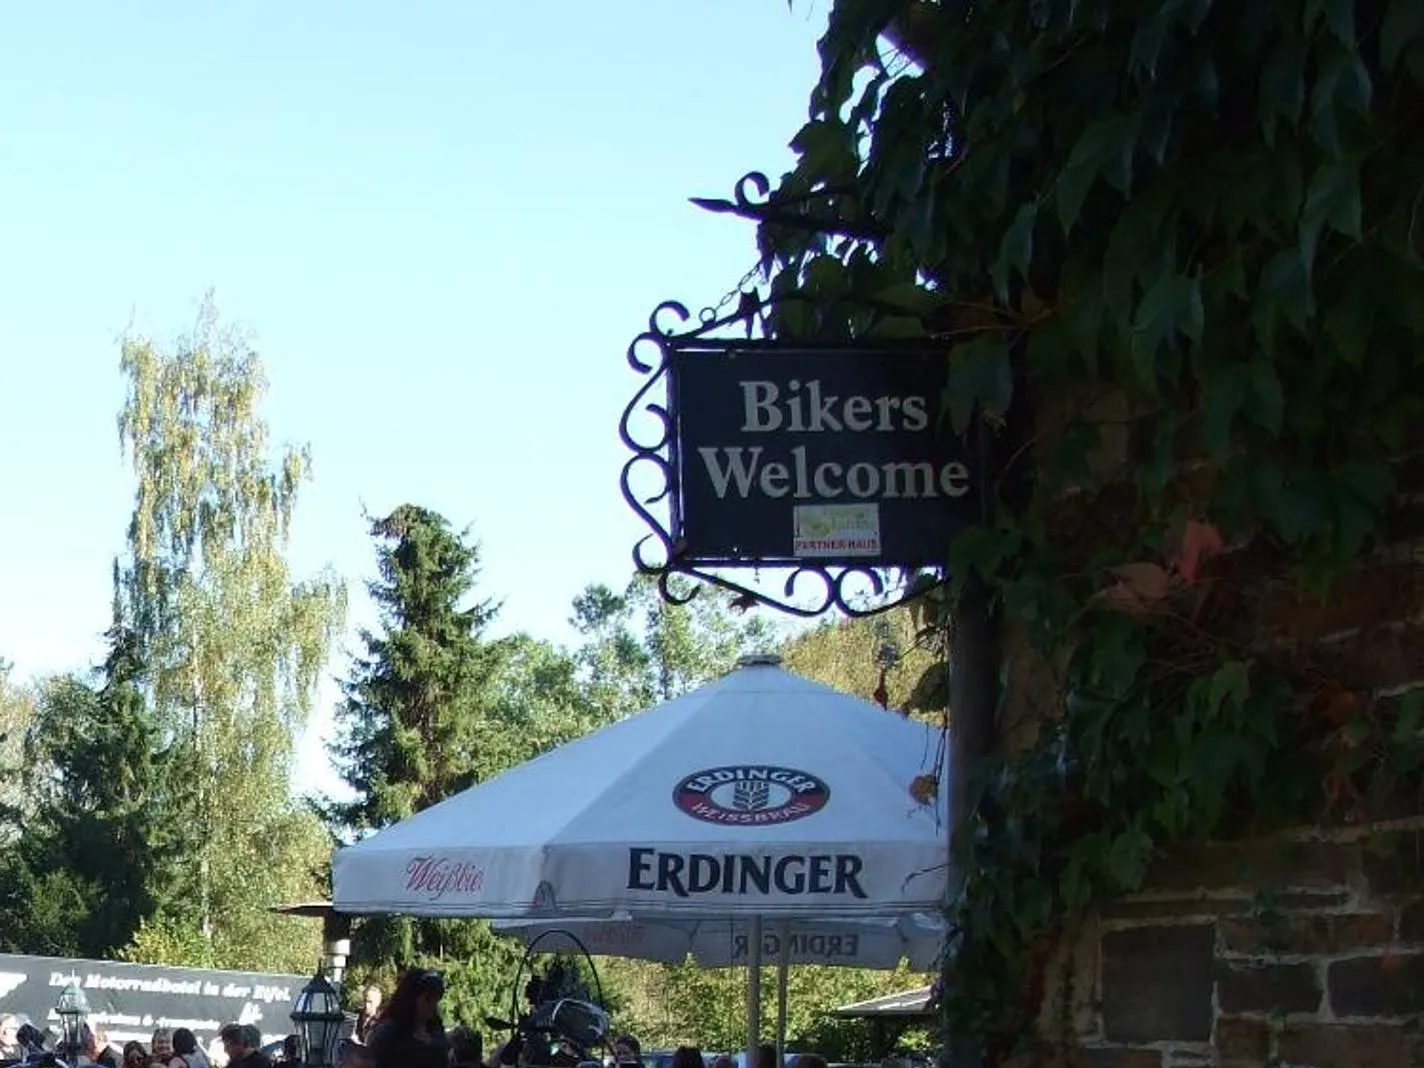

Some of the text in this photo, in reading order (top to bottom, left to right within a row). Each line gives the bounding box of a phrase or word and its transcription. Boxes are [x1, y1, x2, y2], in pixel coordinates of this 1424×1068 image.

[739, 379, 929, 432] Bikers
[697, 445, 971, 500] Welcome
[686, 768, 817, 794] ERDINGER
[627, 847, 868, 899] ERDINGER
